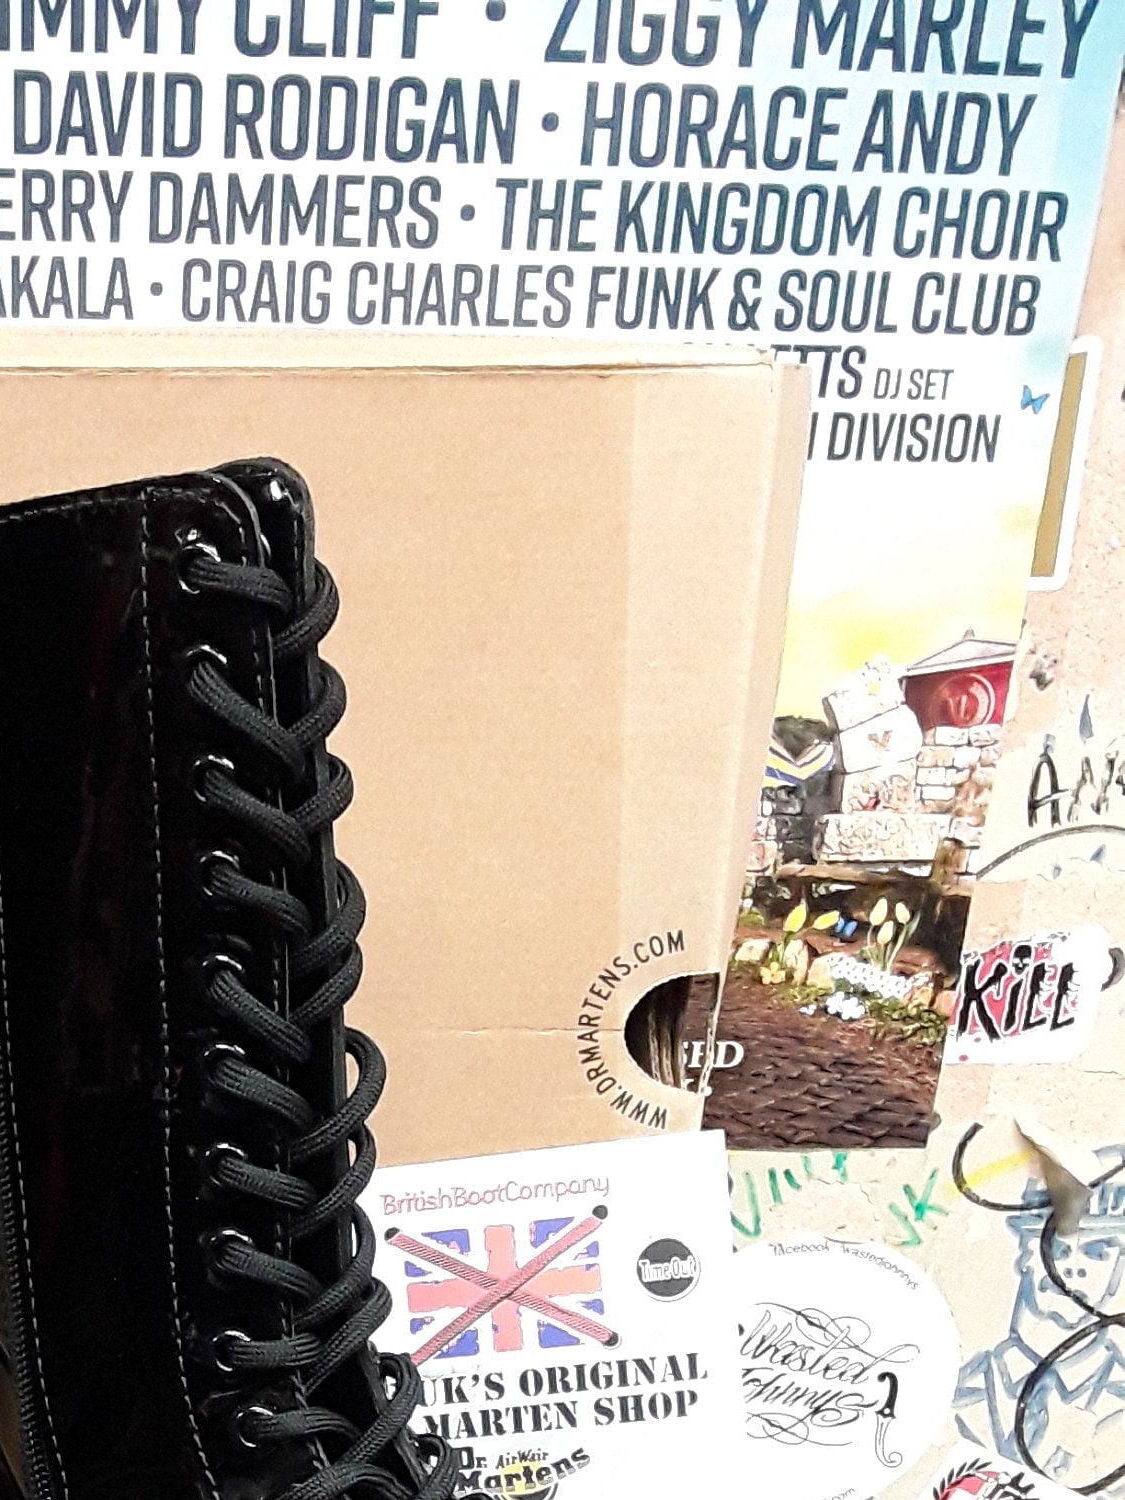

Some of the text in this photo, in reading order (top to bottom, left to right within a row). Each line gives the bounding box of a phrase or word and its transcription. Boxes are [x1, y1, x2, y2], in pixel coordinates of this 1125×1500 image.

[233, 0, 439, 59] CLIFF
[544, 0, 768, 68] ZIGGY
[790, 0, 1100, 79] MARLEY
[14, 69, 1039, 177] DAVID RODIGAN HORACE ANDY
[148, 171, 442, 249] DAMMERS
[496, 178, 602, 253] THE
[614, 180, 881, 258] KINGDOM
[891, 186, 1069, 263] CHOIR
[182, 258, 332, 324] CRAIG
[346, 260, 574, 328] CHARLES
[585, 265, 723, 332] FUNK
[727, 267, 762, 332] &
[775, 269, 900, 335] SOUL
[911, 271, 1042, 337] CLUB
[872, 367, 903, 400] DJ
[906, 367, 955, 401] SET
[826, 411, 1002, 463] DIVISION
[381, 1174, 610, 1217] BritishBootCompany
[518, 1352, 709, 1398] ORIGINAL
[422, 1388, 700, 1442] MARTEN SHOP
